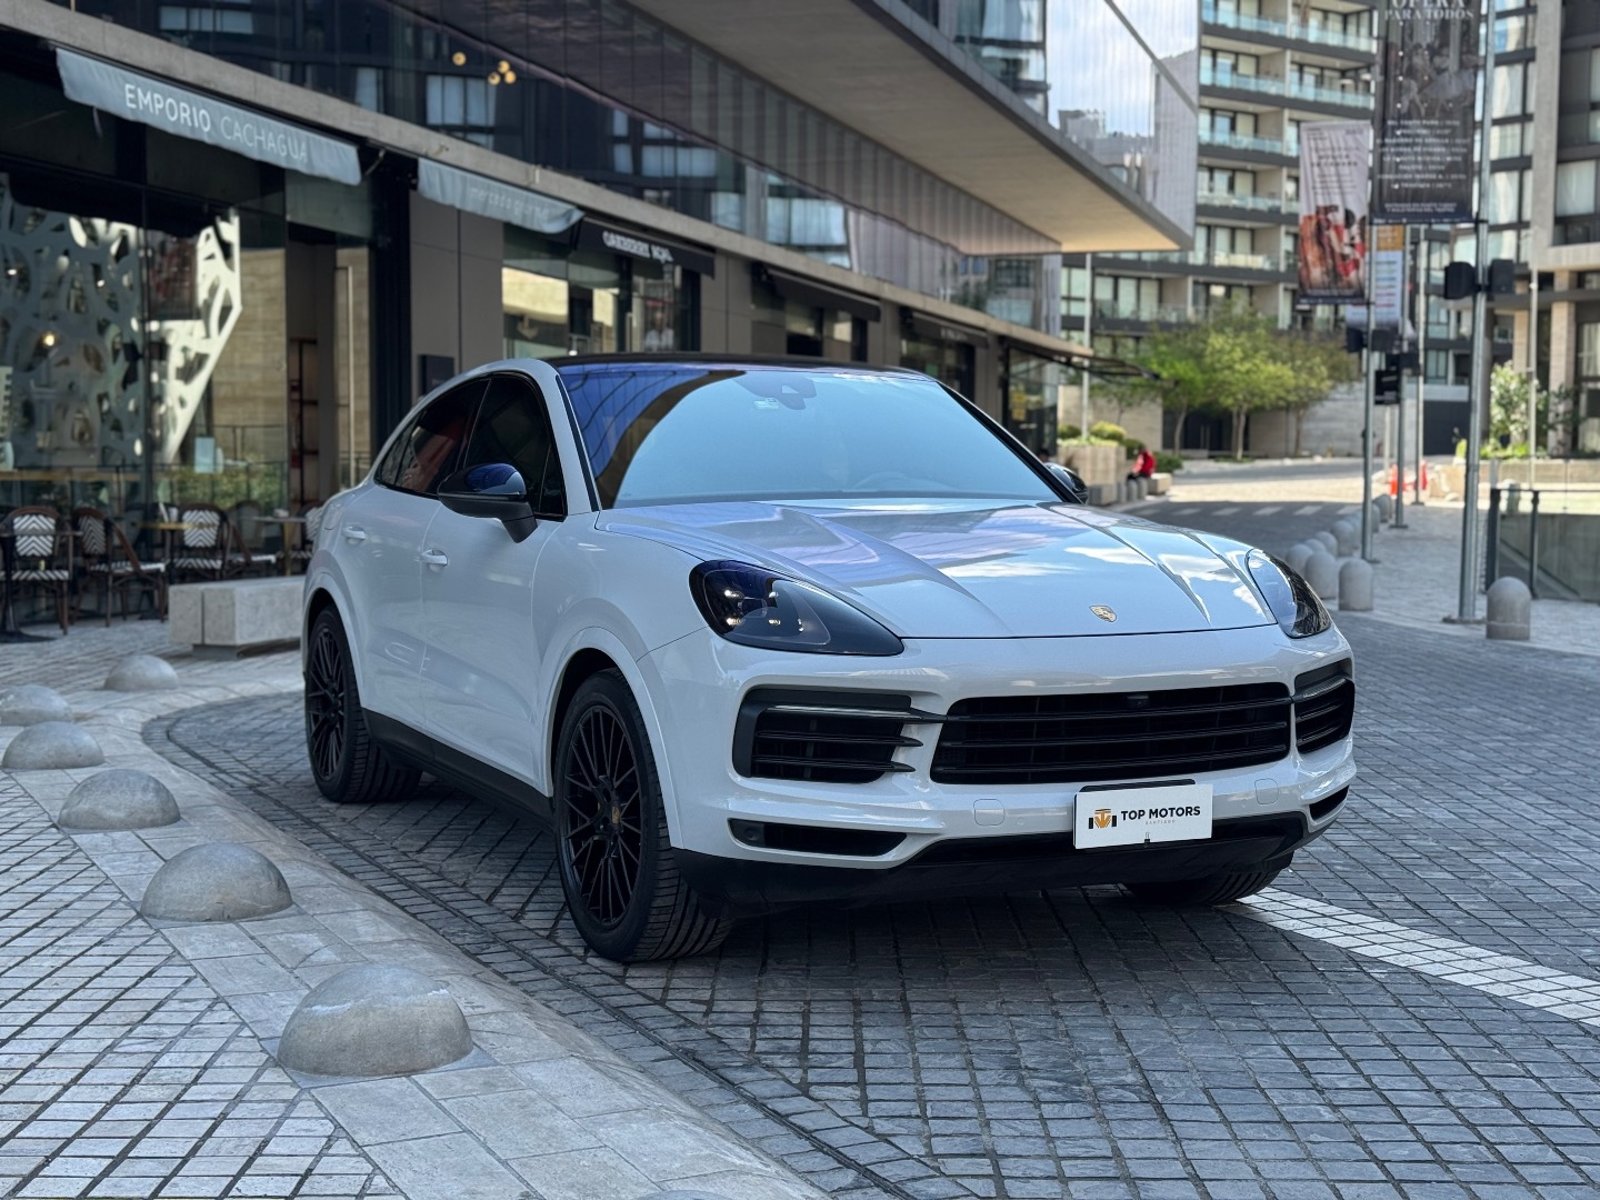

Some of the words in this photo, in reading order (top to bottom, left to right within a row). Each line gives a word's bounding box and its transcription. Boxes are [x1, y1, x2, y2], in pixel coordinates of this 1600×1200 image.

[1384, 9, 1422, 20] PARA
[1424, 9, 1474, 20] TODOS
[124, 83, 211, 133] EMPORIO
[220, 116, 308, 163] CACHAGUA
[1121, 809, 1146, 821] TOP
[1149, 805, 1201, 819] MOTORS
